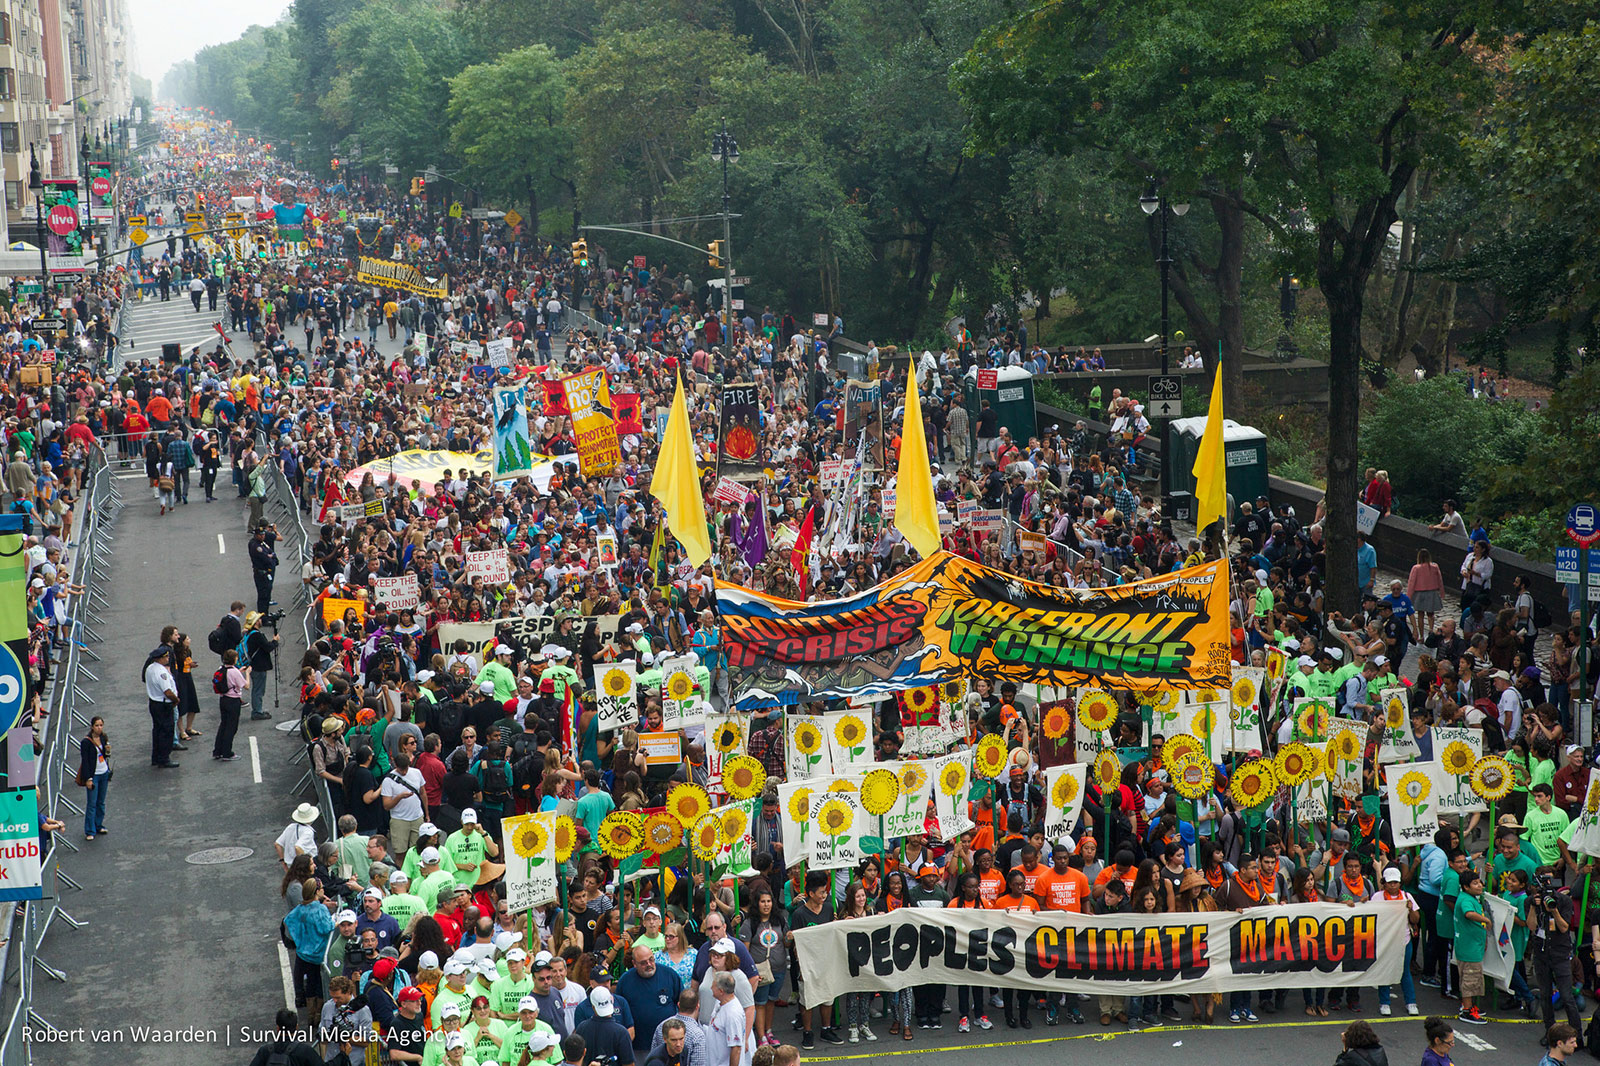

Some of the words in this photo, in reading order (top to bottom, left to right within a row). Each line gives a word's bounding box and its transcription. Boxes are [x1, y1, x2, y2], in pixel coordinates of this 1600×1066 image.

[93, 182, 108, 190] live
[51, 214, 74, 225] live
[19, 285, 26, 293] W
[565, 374, 592, 393] IDLE
[723, 388, 756, 406] FIRE
[577, 424, 616, 446] PROTECT
[579, 437, 618, 457] GRANDMOTHER
[584, 450, 618, 467] EARTH
[823, 471, 850, 480] LAKTA
[733, 481, 749, 493] FRACK
[466, 552, 490, 562] KEEP
[491, 549, 506, 559] THE
[1558, 549, 1577, 559] M10
[468, 563, 483, 572] OIL
[1558, 561, 1577, 571] M20
[374, 577, 398, 588] KEEP
[400, 575, 416, 585] THE
[1181, 576, 1213, 584] PEOPLE!
[390, 588, 404, 597] OIL
[721, 592, 927, 641] FRONTLINES
[724, 640, 772, 667] OF
[774, 616, 916, 663] CRISIS
[950, 622, 991, 654] OF
[993, 629, 1188, 674] CHANGE
[1200, 667, 1213, 677] THE
[598, 696, 617, 708] FOR
[617, 711, 632, 723] TE
[664, 710, 680, 718] ROOTS
[1435, 728, 1458, 740] PEOPLE
[1459, 728, 1481, 746] POWER
[1185, 755, 1200, 764] THE
[810, 793, 831, 819] CLIMATE
[835, 792, 859, 810] JUSTICE
[1439, 796, 1447, 808] in
[608, 815, 624, 824] Build
[888, 812, 923, 831] green
[892, 823, 922, 836] love
[816, 840, 831, 849] NOW
[816, 852, 832, 861] NOW
[839, 850, 855, 858] NOW
[846, 924, 1017, 978] PEOPLES
[1033, 924, 1209, 974] CLIMATE
[1236, 915, 1377, 968] MARCH
